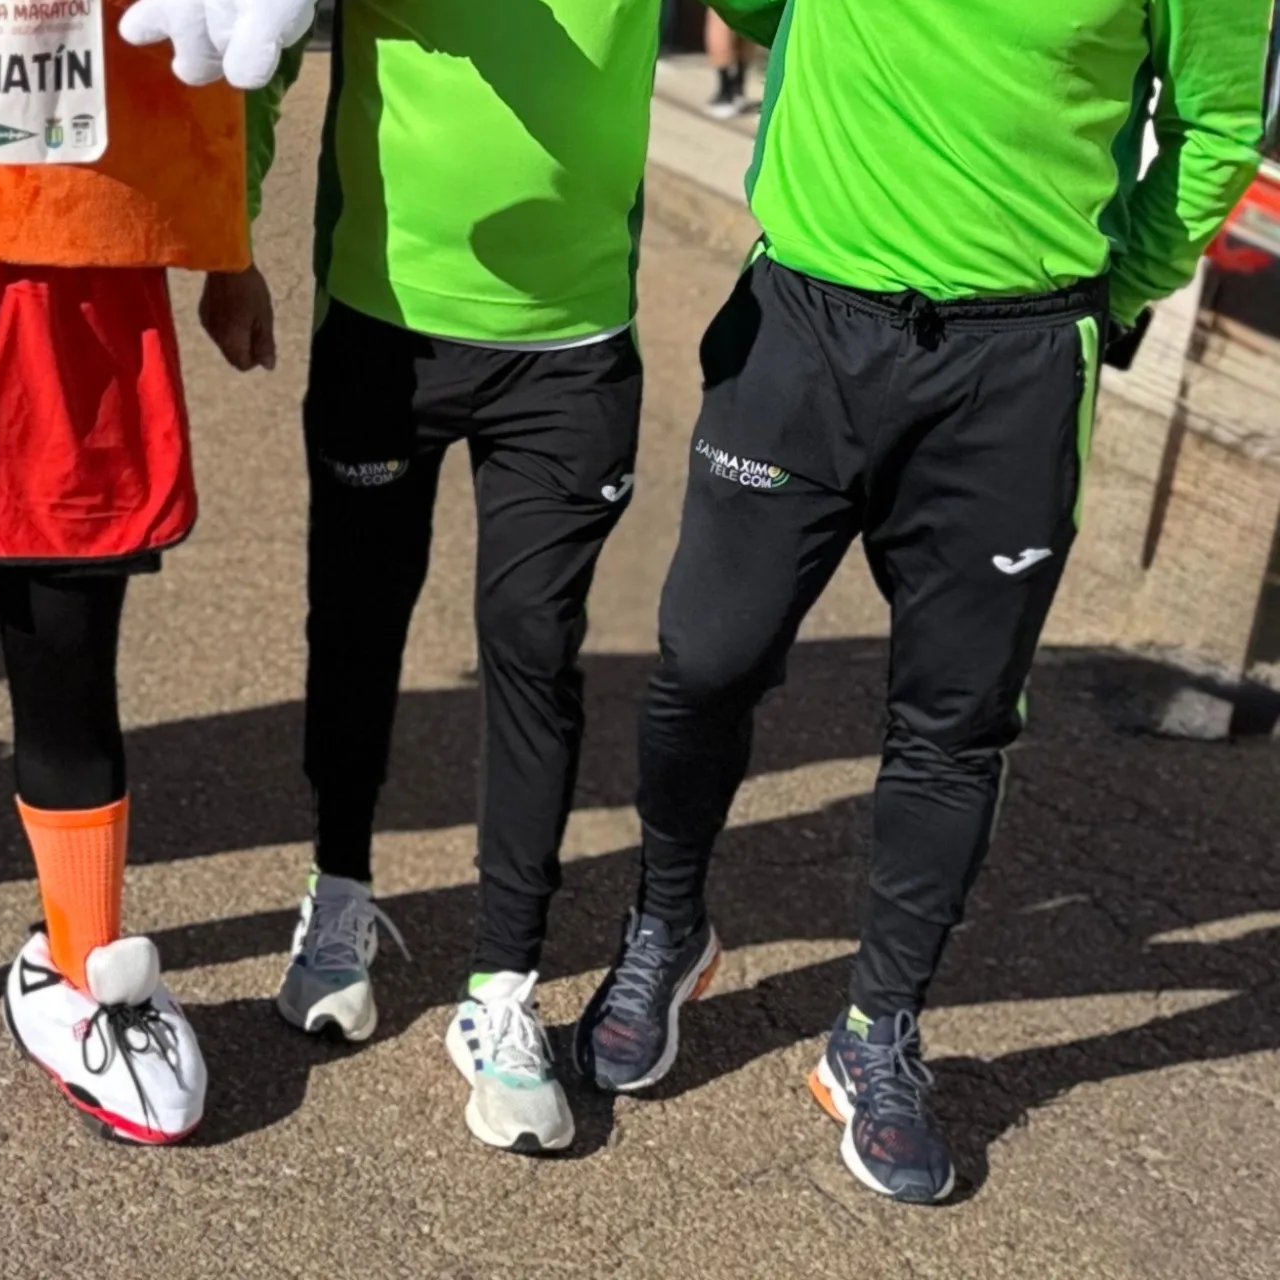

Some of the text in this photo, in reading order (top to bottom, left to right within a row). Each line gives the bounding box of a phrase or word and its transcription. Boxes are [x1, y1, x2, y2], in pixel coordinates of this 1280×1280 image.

[318, 447, 400, 477] MAXIMO
[695, 438, 781, 478] SANMAXIMO
[709, 461, 772, 489] TELECOM
